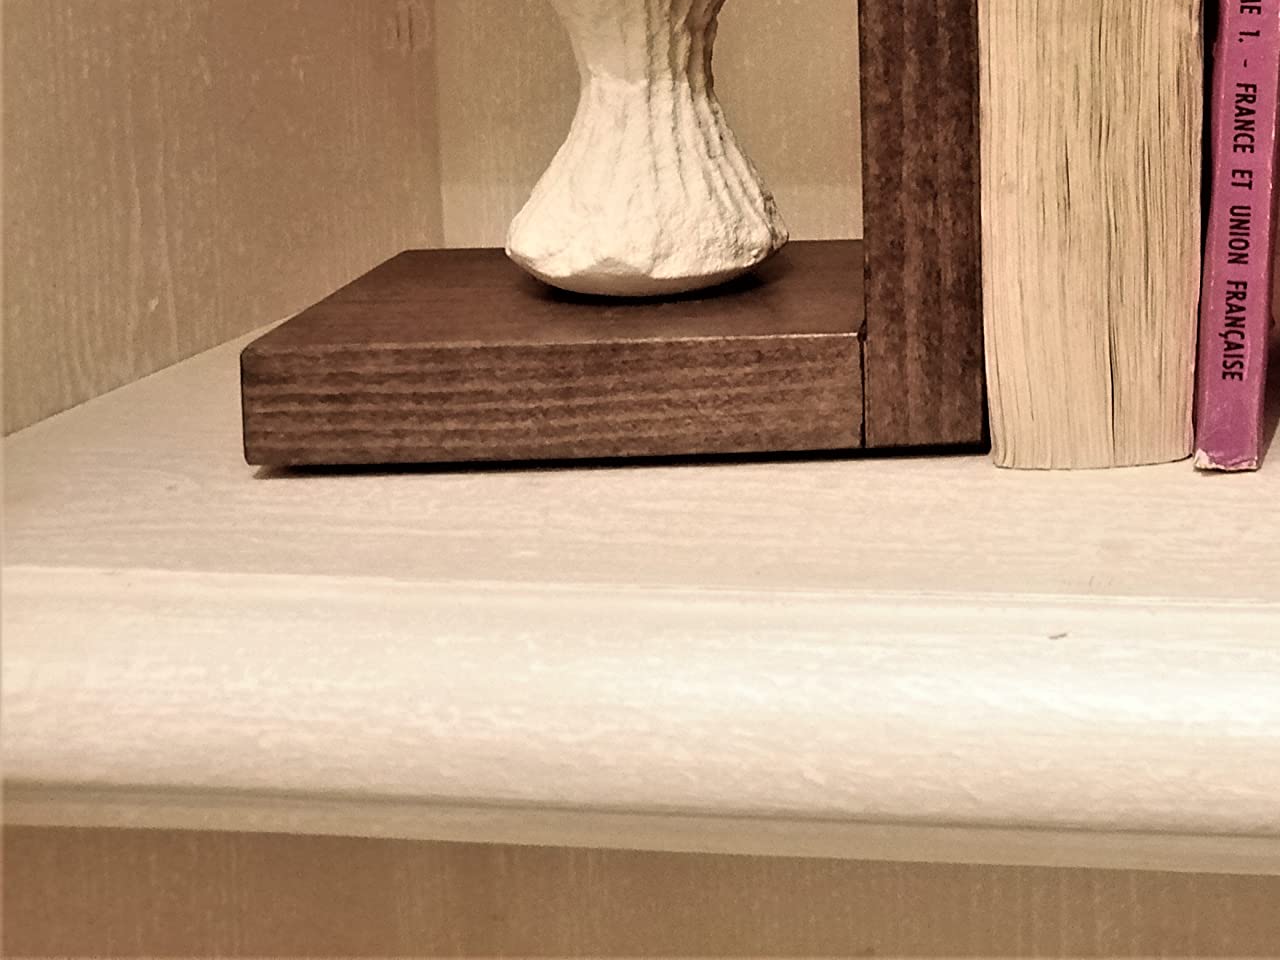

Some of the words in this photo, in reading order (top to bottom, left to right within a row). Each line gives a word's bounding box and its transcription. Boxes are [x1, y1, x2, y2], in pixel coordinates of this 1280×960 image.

[1238, 30, 1260, 43] 1.
[1233, 83, 1257, 153] FRANCE
[1231, 169, 1253, 190] ET
[1227, 206, 1251, 264] UNION
[1218, 280, 1247, 381] FRANÇAISE
